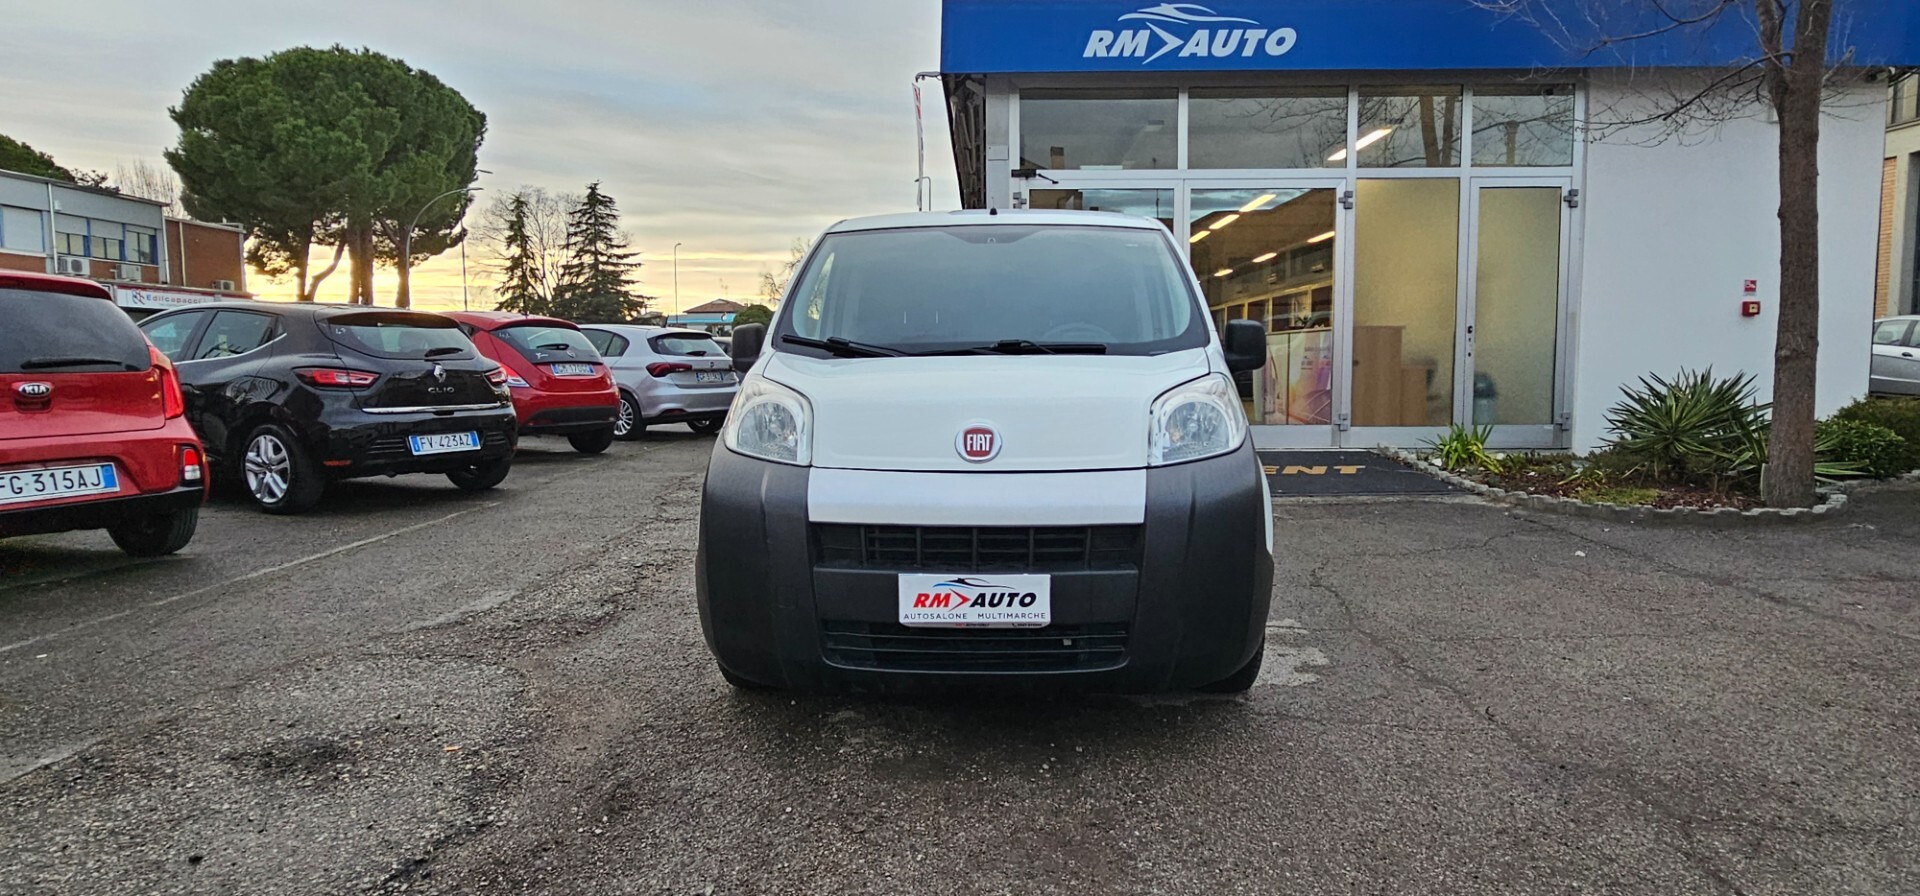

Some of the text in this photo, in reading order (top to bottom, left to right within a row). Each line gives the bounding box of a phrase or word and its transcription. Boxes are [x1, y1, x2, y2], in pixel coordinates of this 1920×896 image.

[1178, 27, 1297, 58] AUTO
[24, 385, 48, 394] KIA
[966, 433, 993, 452] FIAT
[969, 592, 1037, 608] AUTO
[904, 612, 1046, 620] AUTOSALONE MULTIMARCHE
